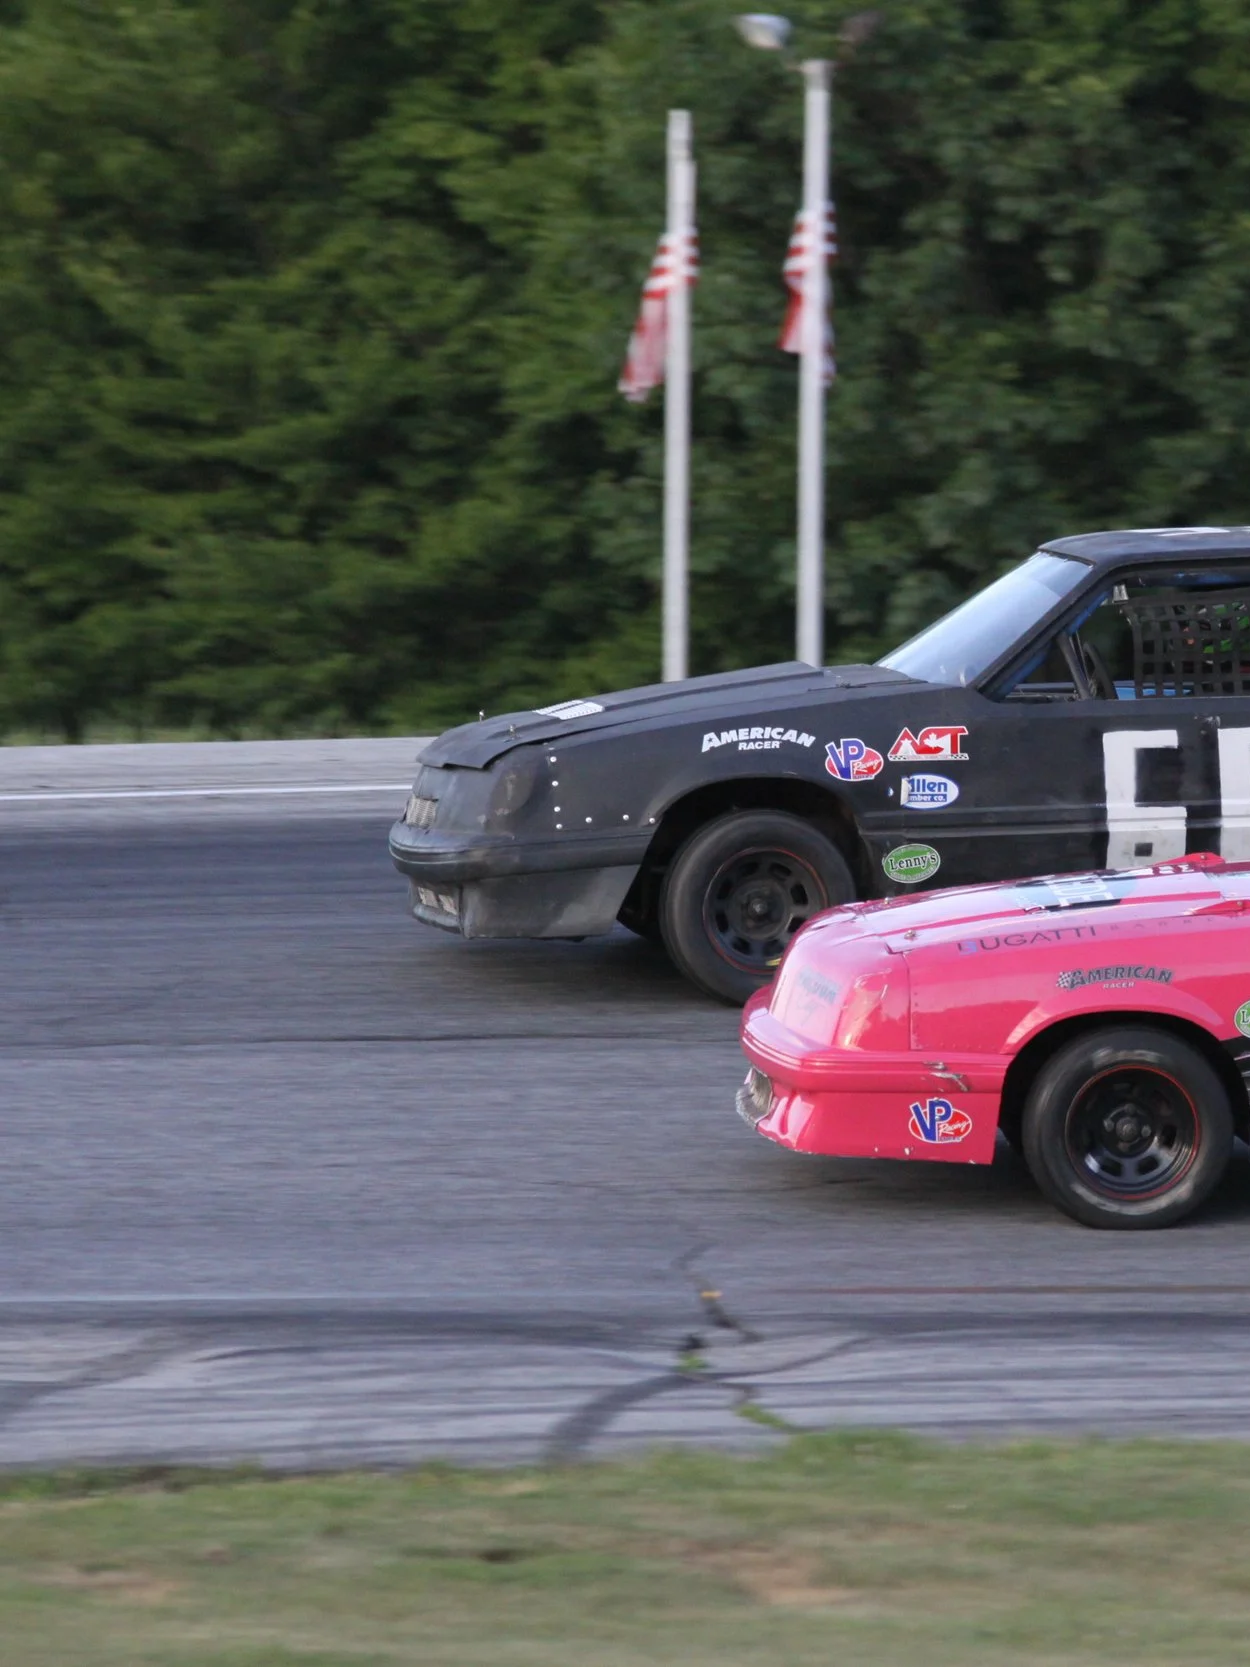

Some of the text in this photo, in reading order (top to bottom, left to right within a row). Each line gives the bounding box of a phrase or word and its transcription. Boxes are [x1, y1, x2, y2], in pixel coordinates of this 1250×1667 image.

[701, 726, 817, 753] AMERICAN
[738, 740, 781, 751] RACER
[825, 738, 866, 780] VP
[889, 853, 937, 870] Lenny's
[1070, 966, 1173, 990] AMERICAN
[1103, 981, 1135, 989] RACER
[909, 1097, 954, 1142] VP
[938, 1120, 971, 1137] Racing
